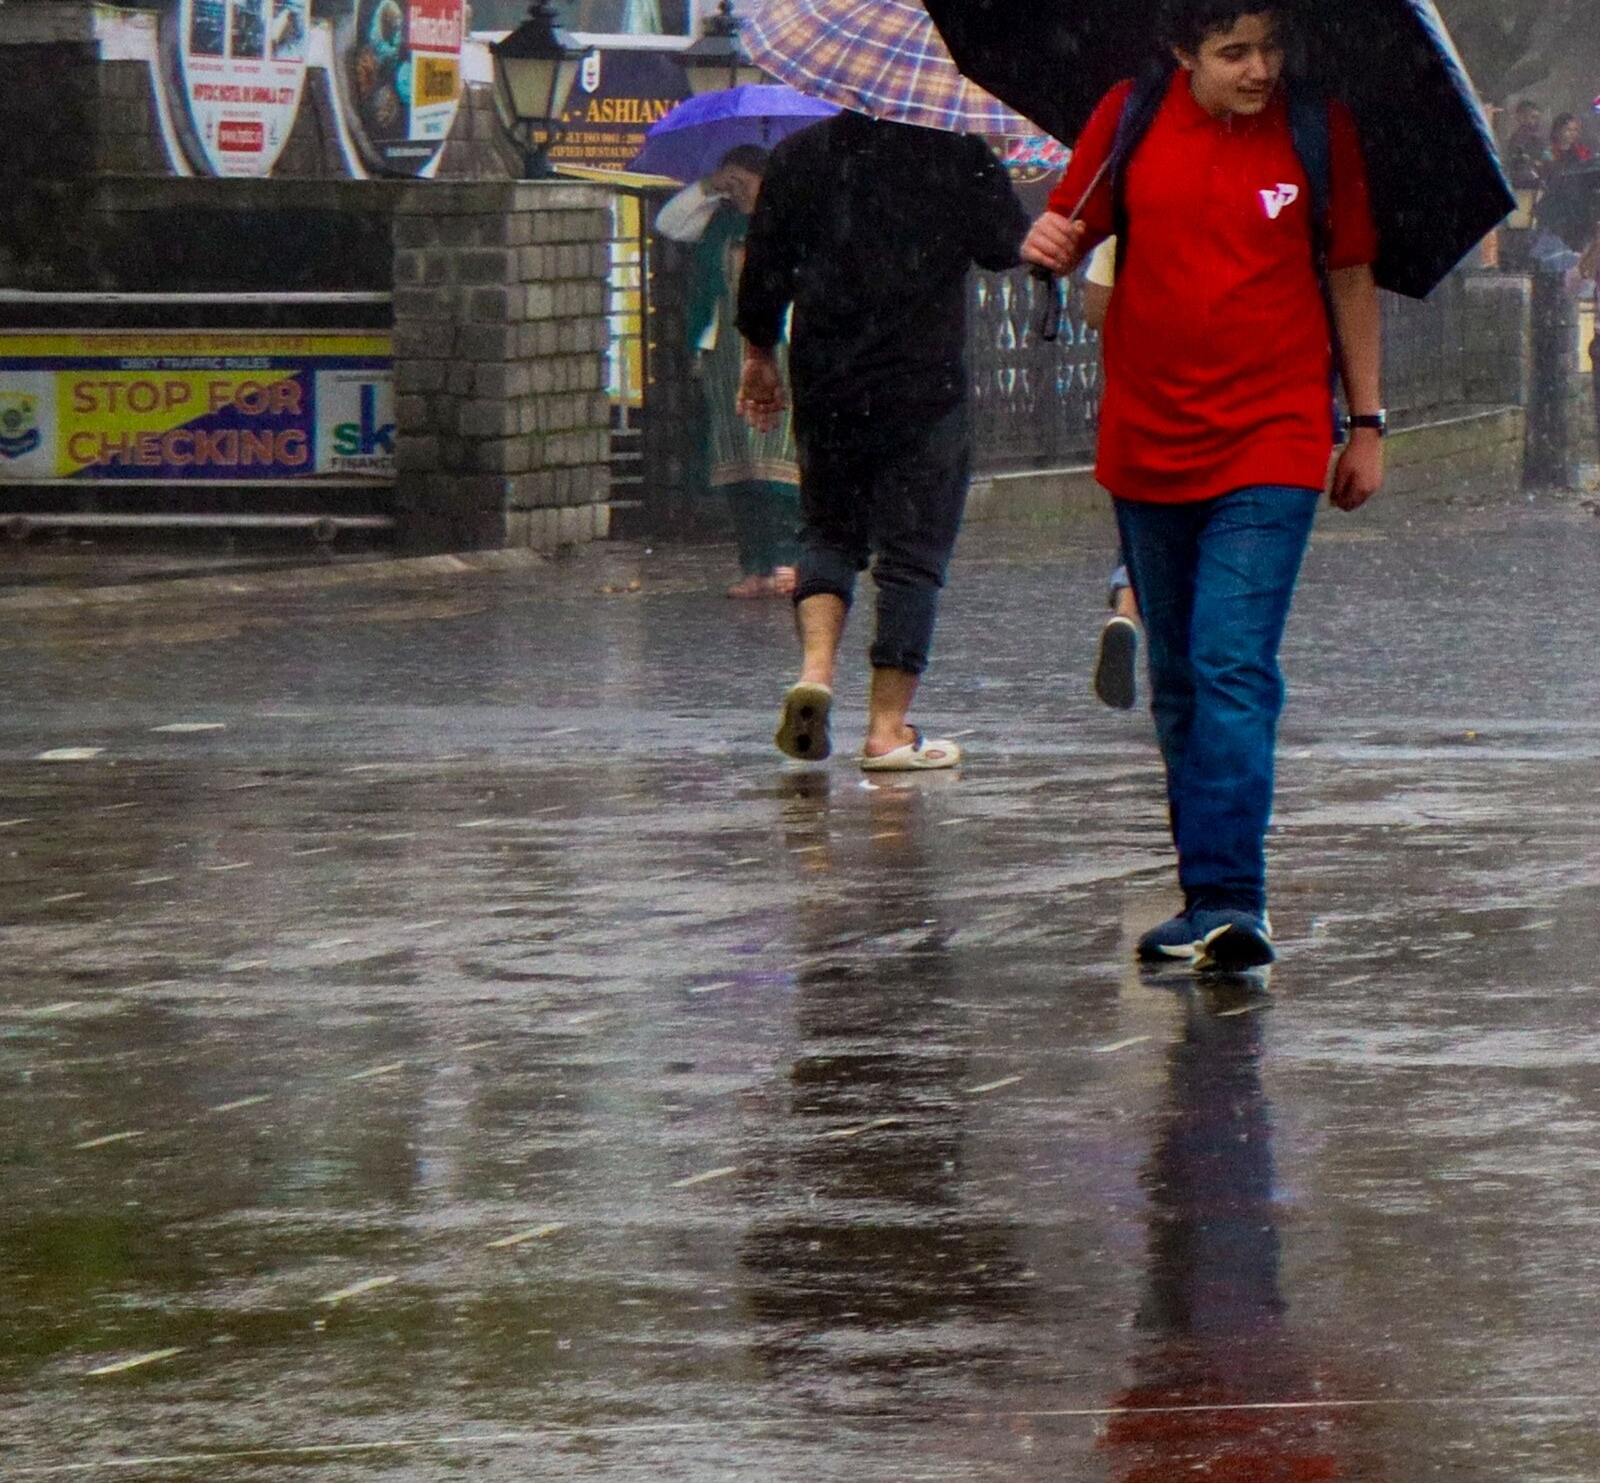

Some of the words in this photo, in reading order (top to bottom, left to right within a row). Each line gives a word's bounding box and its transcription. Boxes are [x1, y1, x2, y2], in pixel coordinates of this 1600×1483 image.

[161, 358, 222, 368] TRAFFIC
[225, 358, 270, 368] RULES
[72, 380, 192, 414] STOP
[207, 380, 302, 415] FOR
[68, 429, 307, 466] CHECKING
